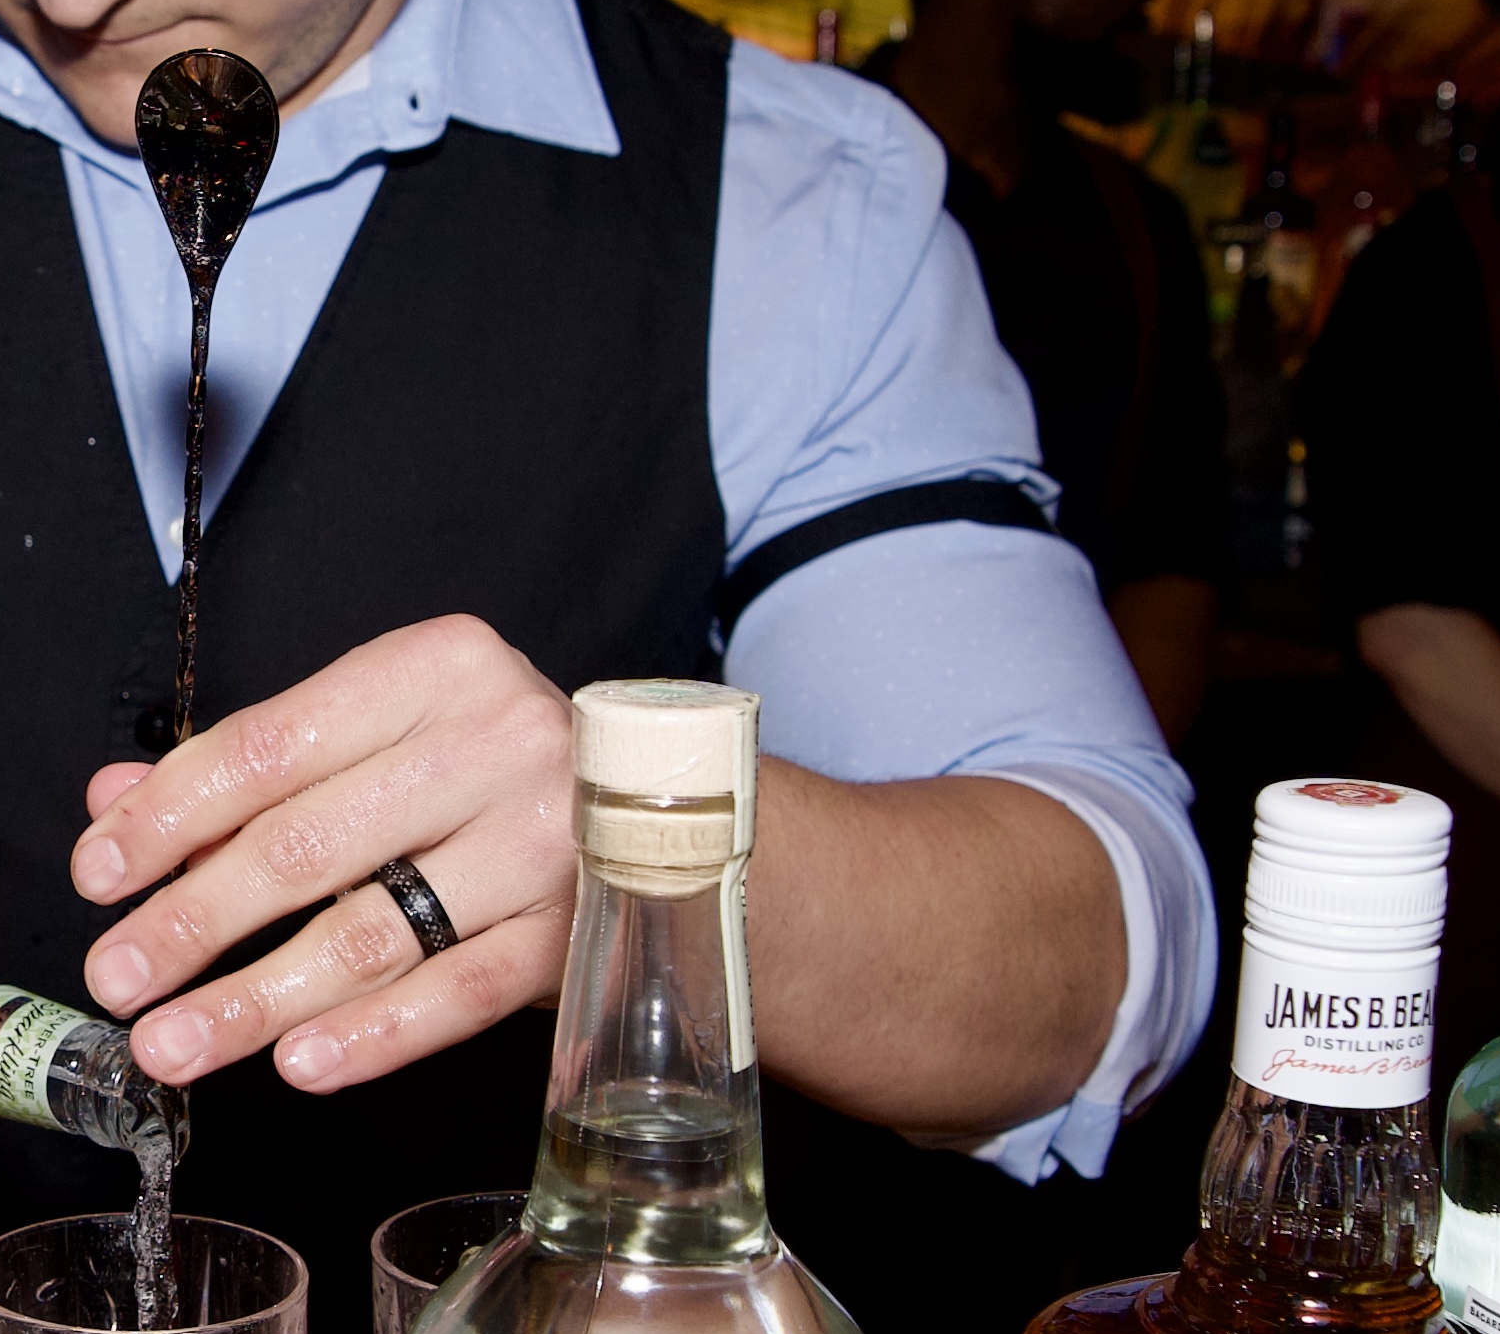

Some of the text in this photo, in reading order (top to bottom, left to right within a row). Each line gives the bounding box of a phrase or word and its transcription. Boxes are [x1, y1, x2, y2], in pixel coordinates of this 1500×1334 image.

[1265, 983, 1361, 1030] JAMES
[1367, 997, 1389, 1030] B.
[24, 1012, 77, 1101] FEVER-TREE
[1304, 1033, 1426, 1052] DISTILLING CO.
